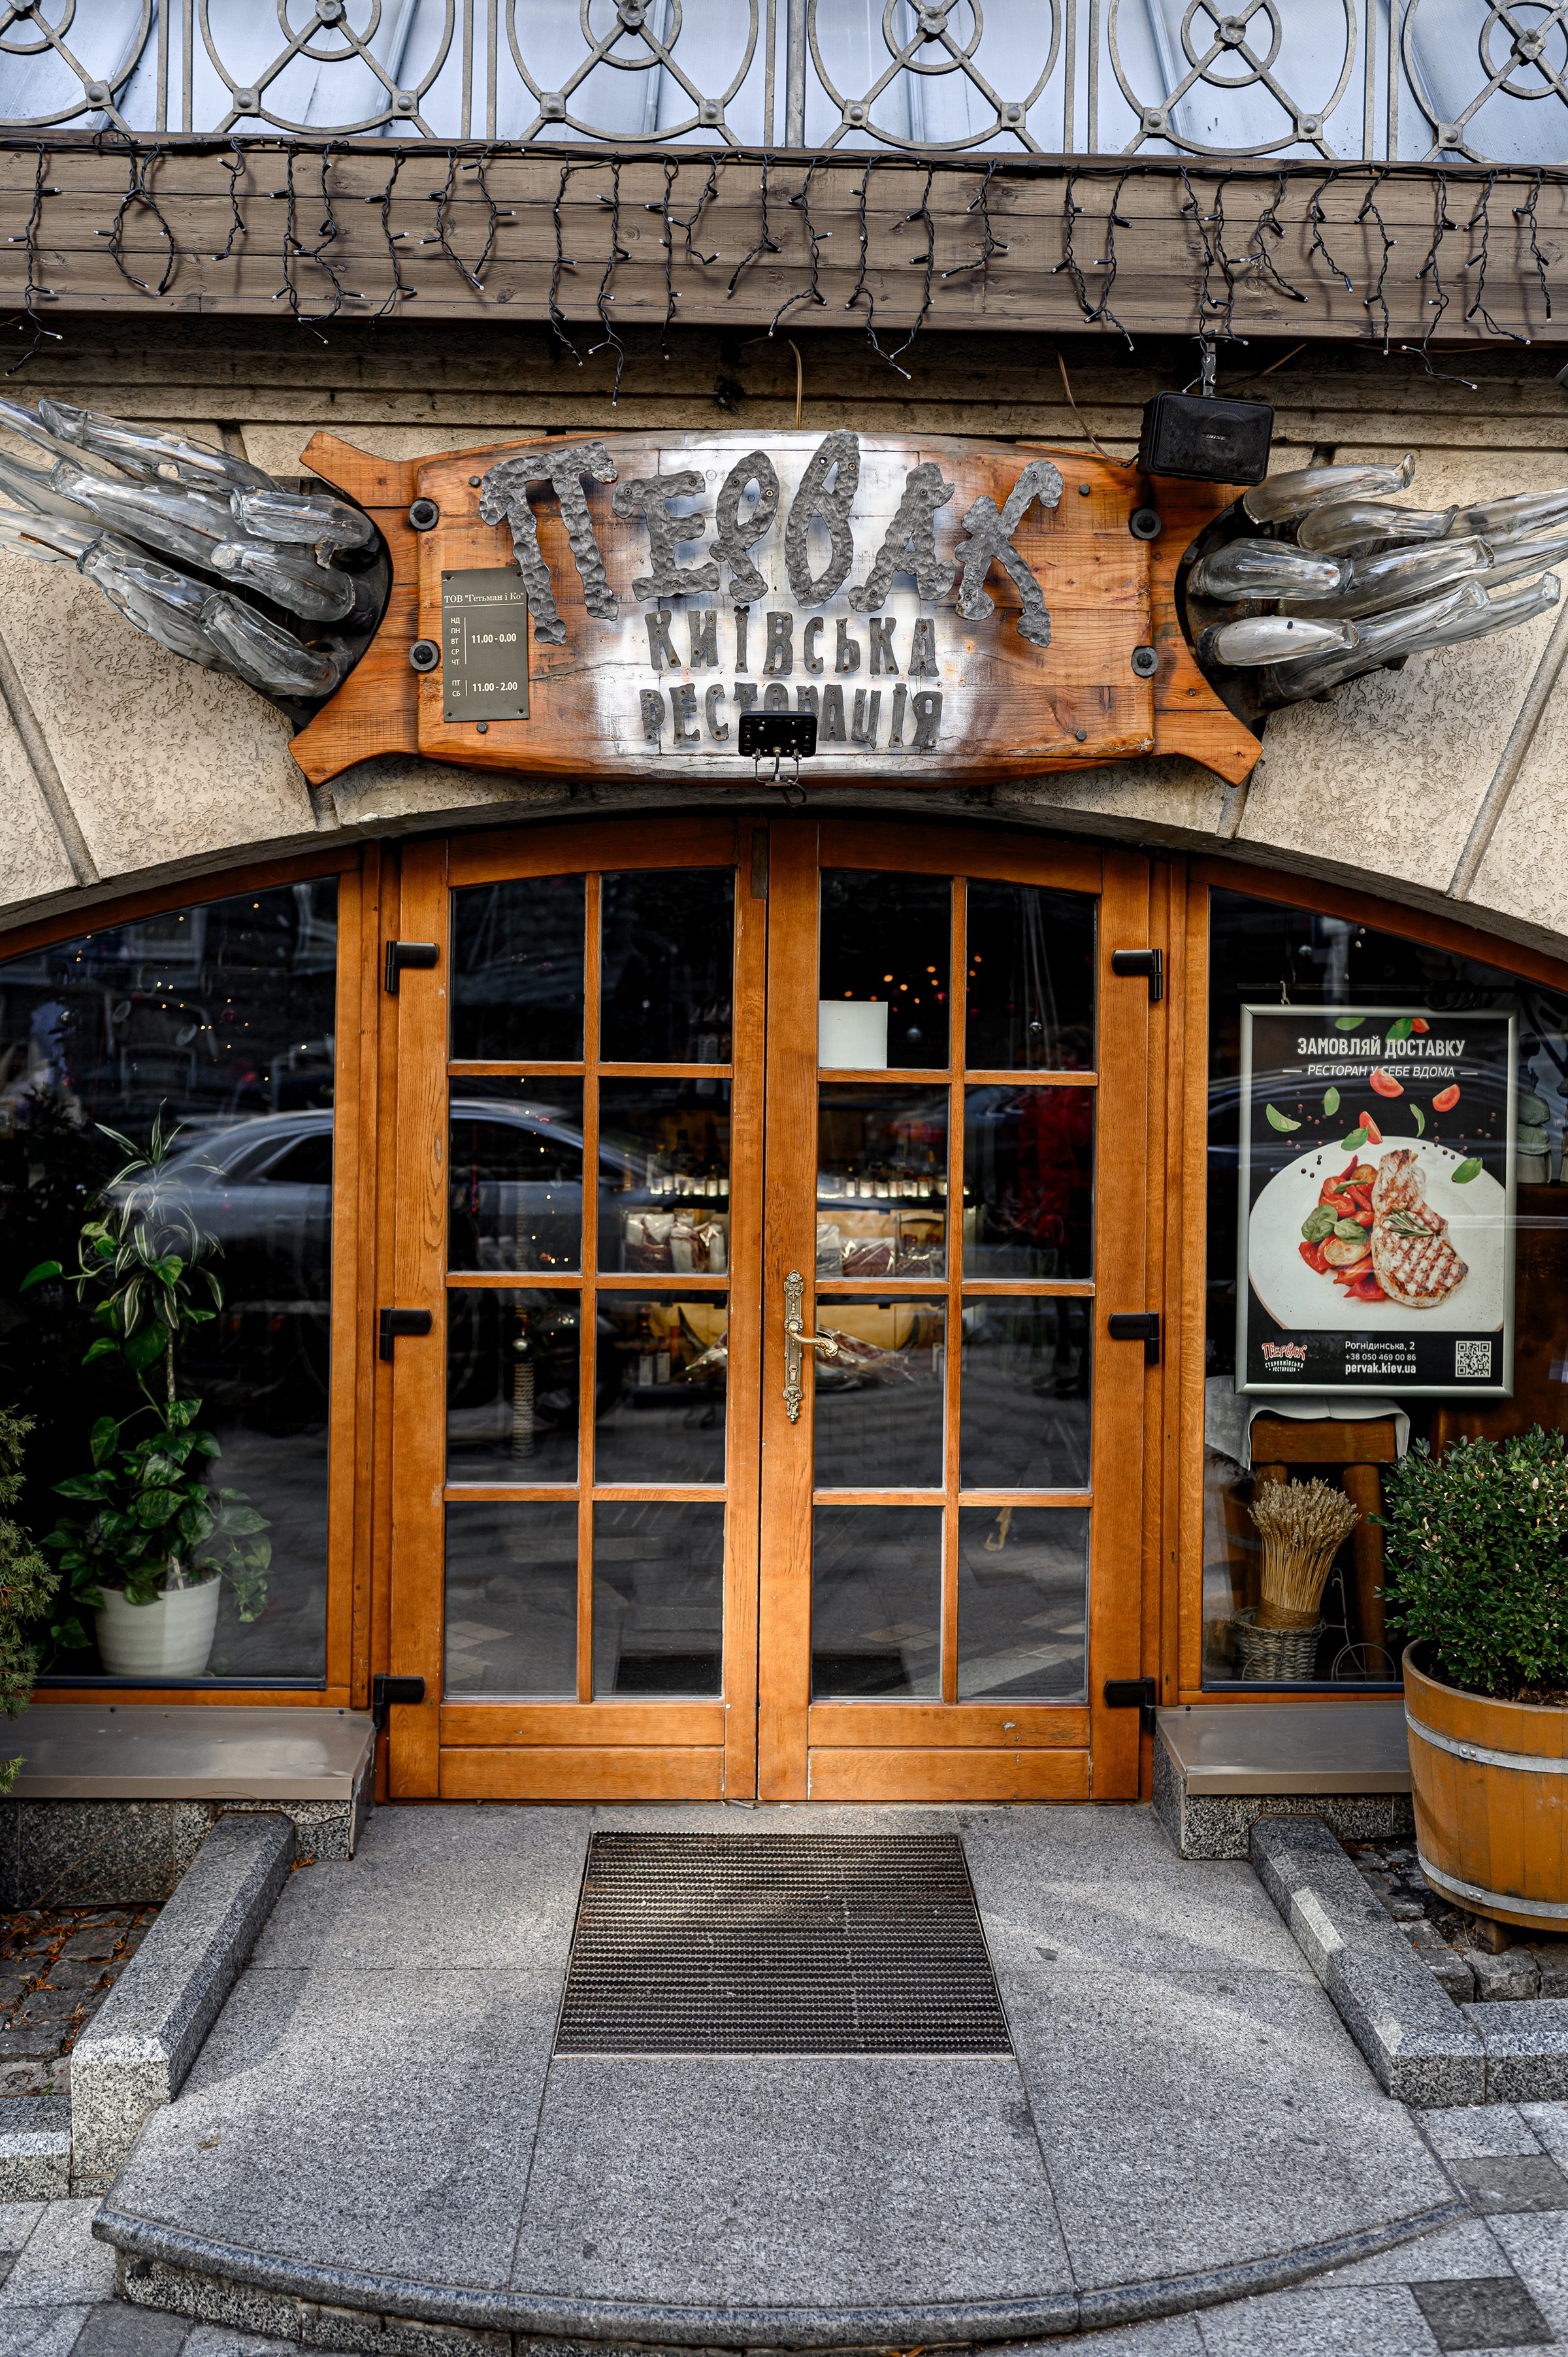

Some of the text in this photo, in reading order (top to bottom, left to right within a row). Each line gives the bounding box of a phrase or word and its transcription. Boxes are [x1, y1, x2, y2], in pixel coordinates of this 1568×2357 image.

[444, 595, 463, 603] ТОВ
[465, 593, 502, 602] "Гетьман
[504, 592, 508, 601] і
[645, 606, 939, 676] КИЇВСЬКА
[1298, 1036, 1465, 1059] ЗАМОВЛЯЙ ДОСТАВКУ
[1308, 1065, 1455, 1079] РЕСТОРАН У СЕБЕ ВДОМА
[1345, 1341, 1415, 1351] Рогнідинська, 2
[1265, 1359, 1304, 1368] СТАРОКИЇВСЬКА
[1345, 1362, 1416, 1375] pervak.kiev.ua
